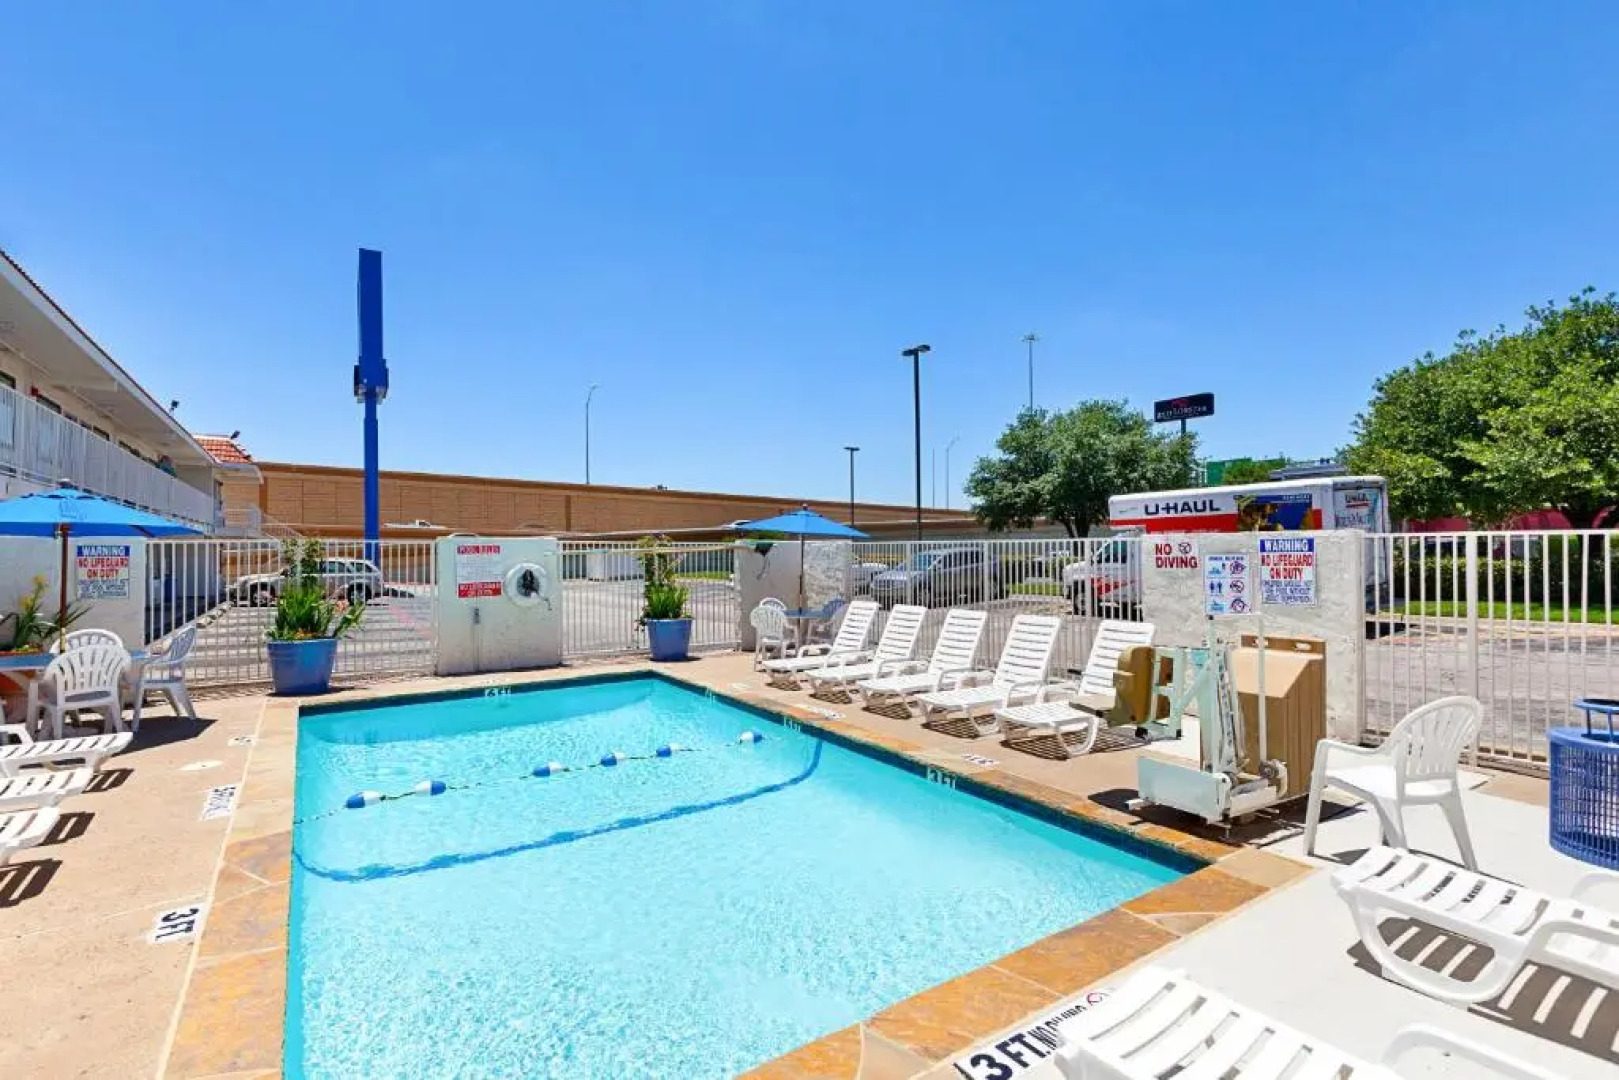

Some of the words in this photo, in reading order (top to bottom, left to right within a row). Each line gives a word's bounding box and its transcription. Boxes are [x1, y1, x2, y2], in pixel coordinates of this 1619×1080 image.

[1145, 499, 1222, 516] U-HAUL
[82, 546, 125, 556] WARNING
[1155, 543, 1172, 556] NO
[1265, 540, 1307, 552] WARNING
[78, 557, 88, 568] NO
[91, 557, 128, 568] LIFEGUARD
[1155, 556, 1198, 569] DIVING
[1261, 554, 1271, 567] NO
[1273, 554, 1312, 567] LIFEGUARD
[87, 568, 98, 578] ON
[100, 568, 119, 578] DUTY
[1270, 567, 1281, 579] ON
[1283, 567, 1304, 580] DUTY
